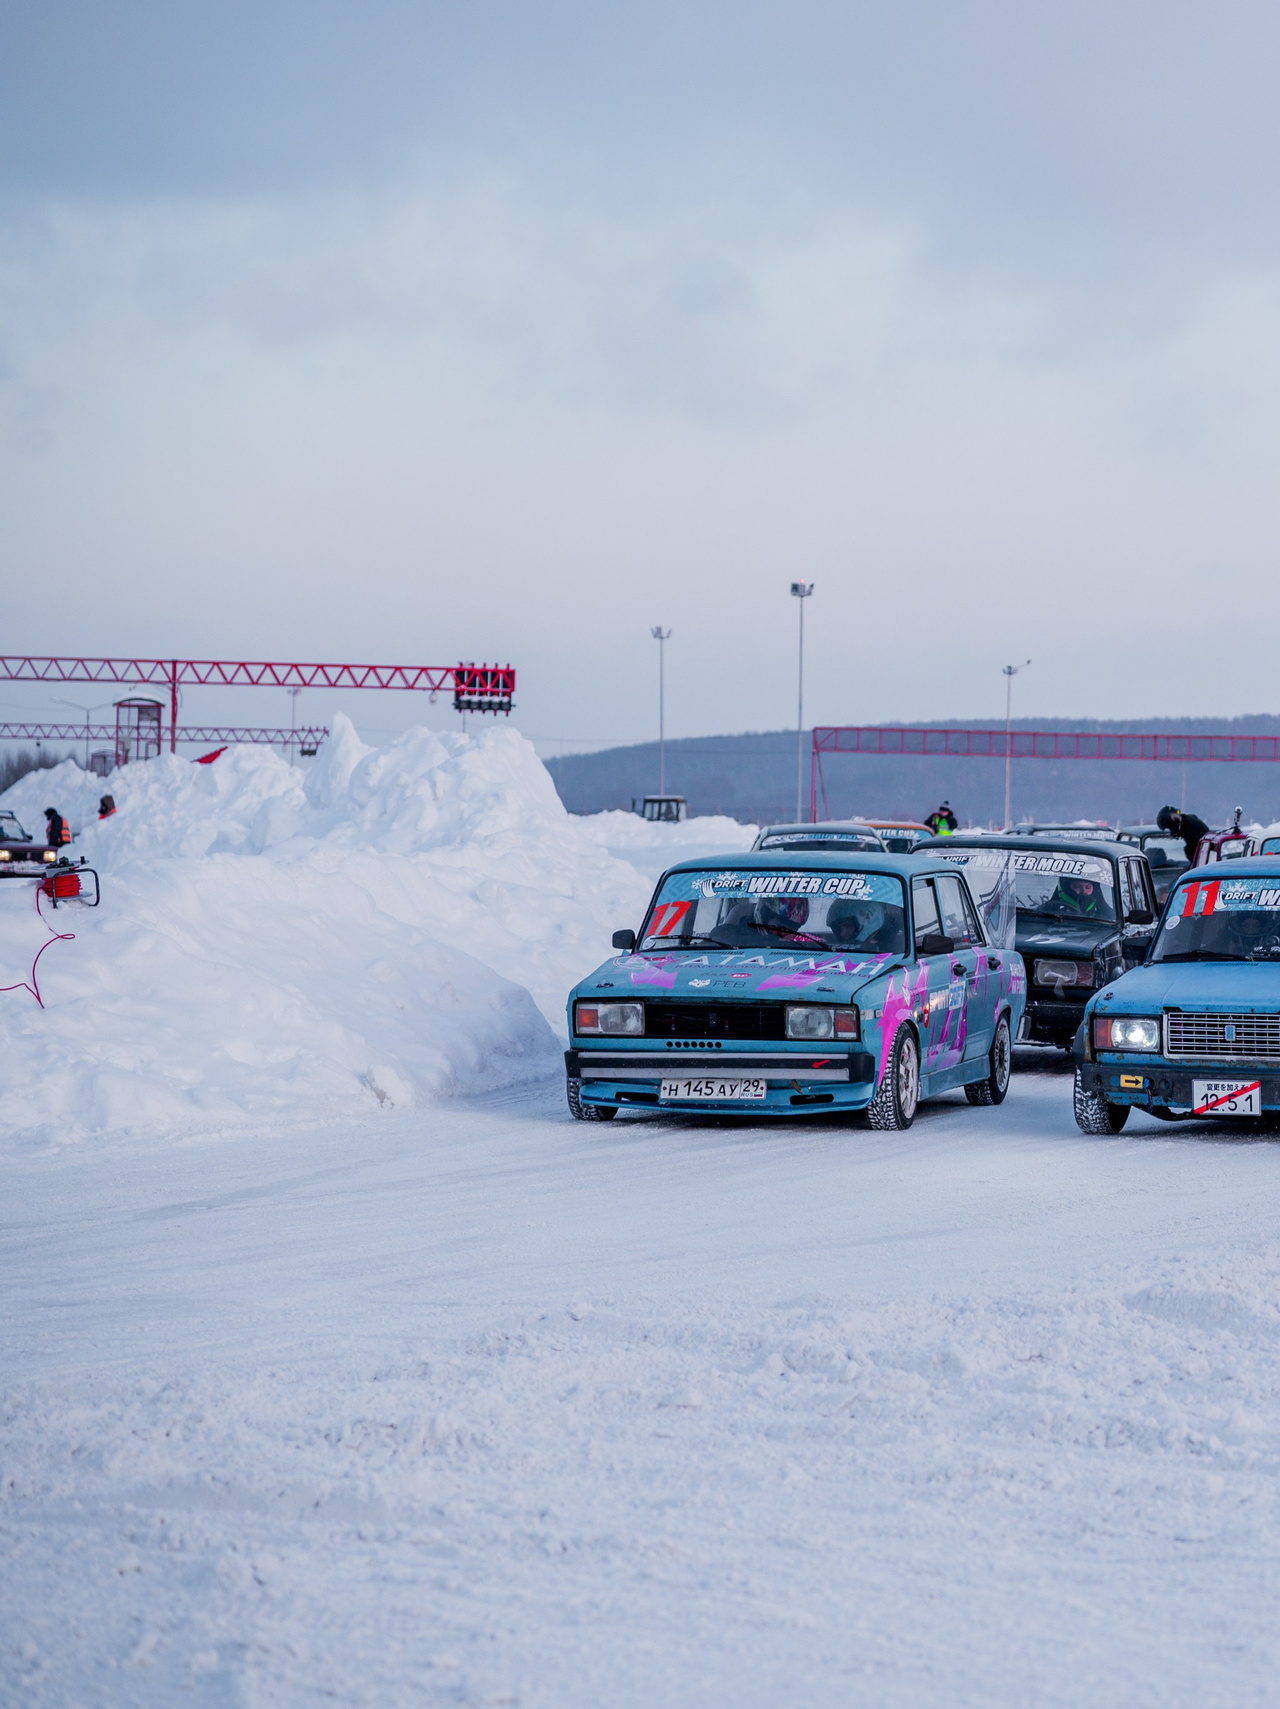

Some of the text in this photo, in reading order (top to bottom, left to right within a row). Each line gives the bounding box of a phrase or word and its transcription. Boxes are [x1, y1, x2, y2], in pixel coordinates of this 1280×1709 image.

[1036, 857, 1085, 875] MODE
[714, 876, 866, 896] DRIFT WINTER CUP
[1225, 890, 1258, 900] DRIFT
[1182, 880, 1221, 917] 11
[647, 900, 692, 936] 17
[743, 1080, 760, 1092] 29
